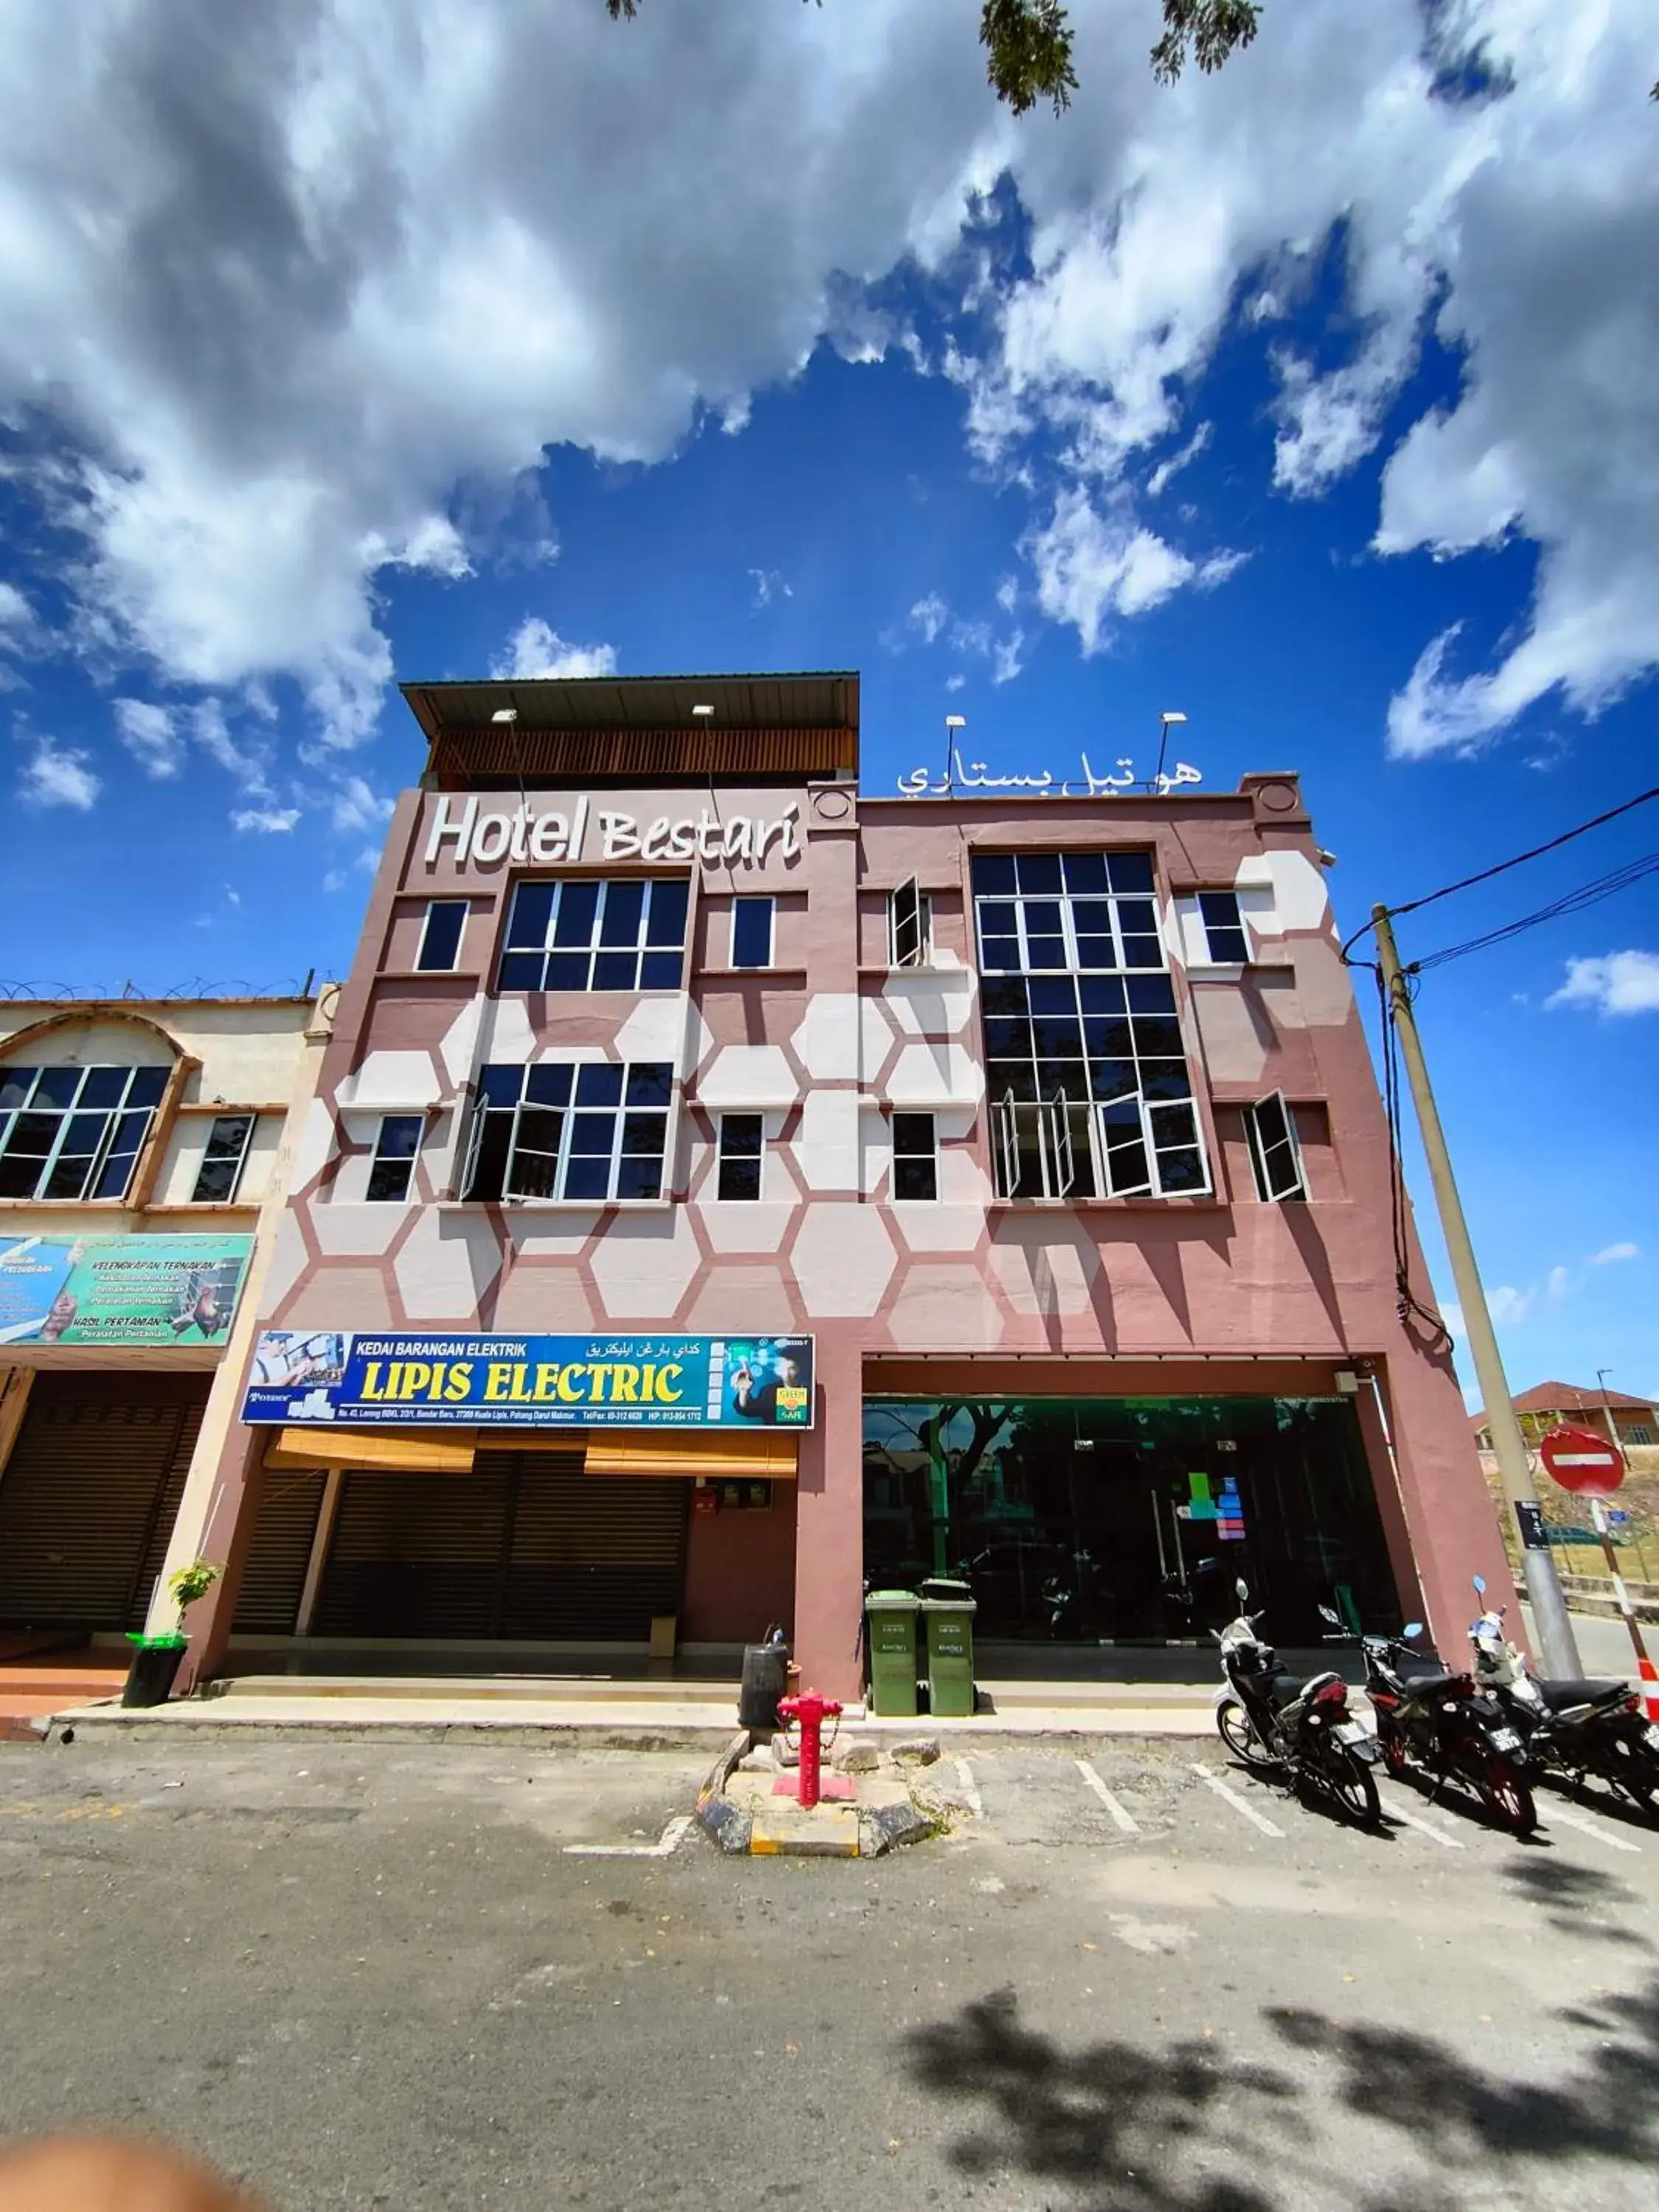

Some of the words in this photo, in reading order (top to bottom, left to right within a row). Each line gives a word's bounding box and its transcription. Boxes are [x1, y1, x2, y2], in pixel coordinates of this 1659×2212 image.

[896, 748, 1053, 799] بستاري
[425, 794, 589, 863] Hotel
[598, 800, 801, 861] Bestari
[92, 1261, 161, 1270] KELENGKAPAN
[163, 1262, 216, 1270] TERNAKAN
[74, 1317, 100, 1326] HASIL
[104, 1318, 161, 1326] PERTANIAN
[356, 1341, 393, 1356] KEDAI
[394, 1341, 465, 1357] BARANGAN
[466, 1342, 527, 1357] ELEKTRIK
[359, 1362, 475, 1402] LIPIS
[483, 1363, 684, 1403] ELECTRIC
